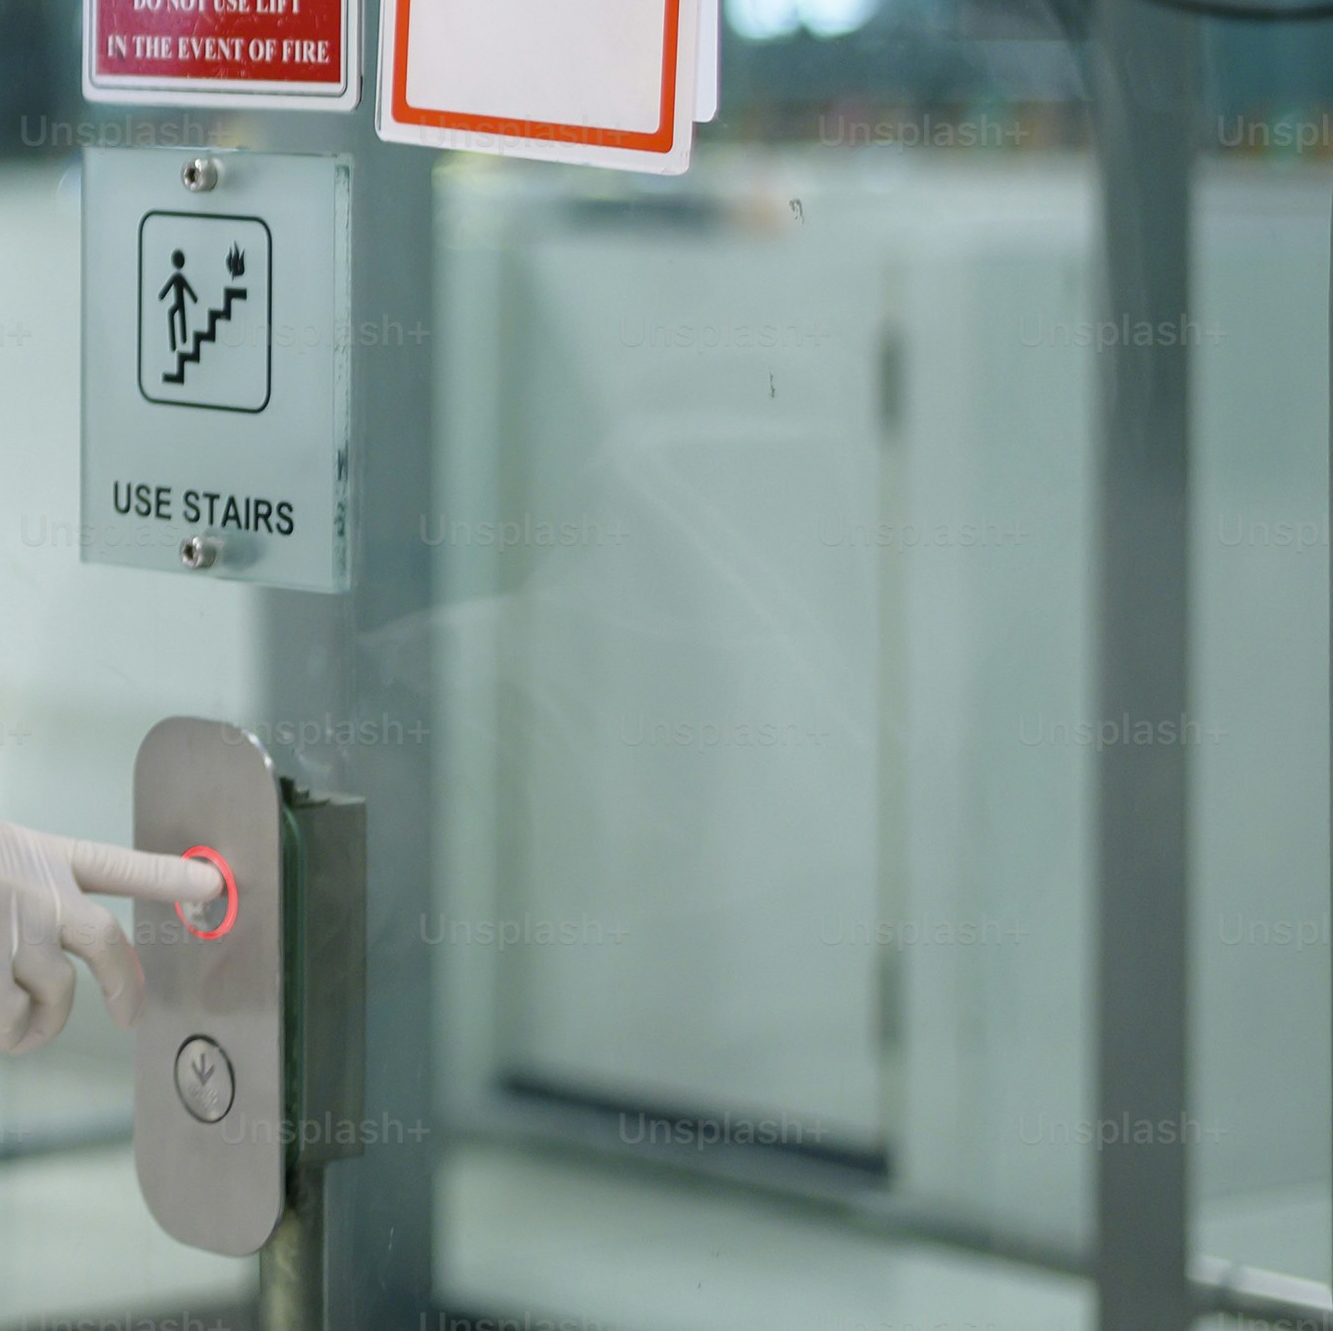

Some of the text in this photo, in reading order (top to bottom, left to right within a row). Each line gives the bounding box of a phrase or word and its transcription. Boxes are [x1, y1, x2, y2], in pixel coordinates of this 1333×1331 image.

[107, 34, 331, 64] IN THE EVENT OF FIRE
[113, 480, 295, 537] USE STAIRS
